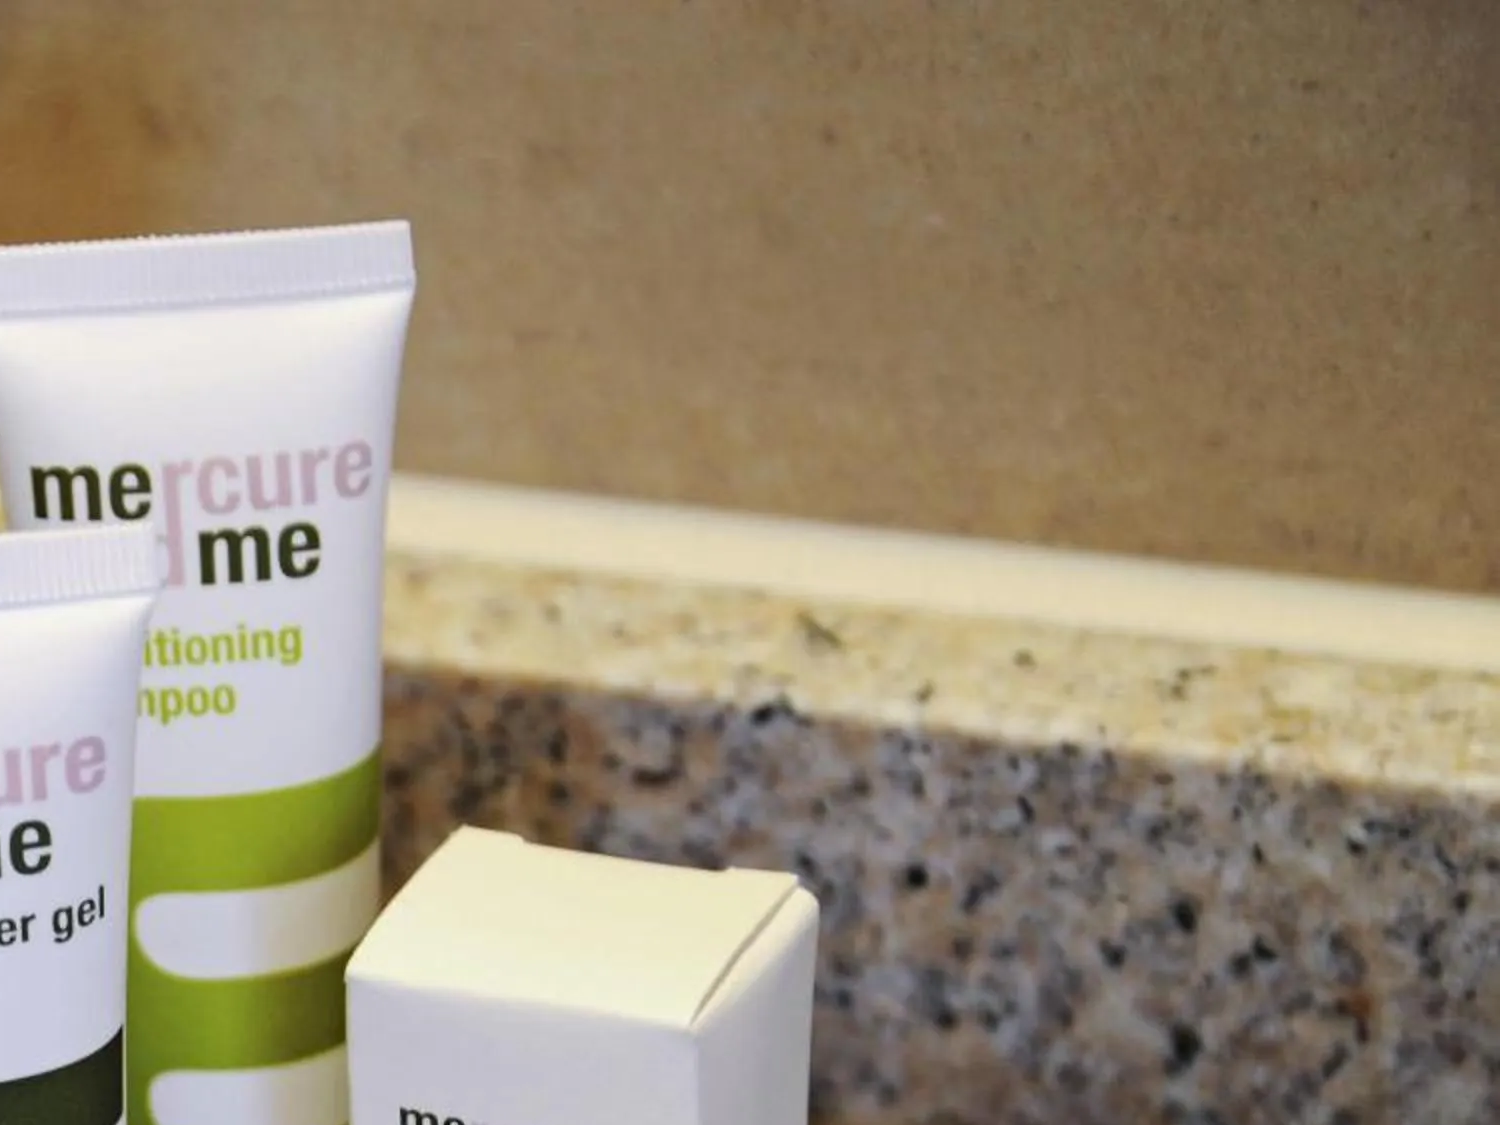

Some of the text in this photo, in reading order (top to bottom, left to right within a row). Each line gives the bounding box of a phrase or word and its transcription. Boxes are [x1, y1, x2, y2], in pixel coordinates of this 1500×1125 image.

[29, 437, 374, 523] mercure
[198, 520, 321, 586] me
[143, 621, 304, 668] itioning
[52, 884, 106, 943] gel
